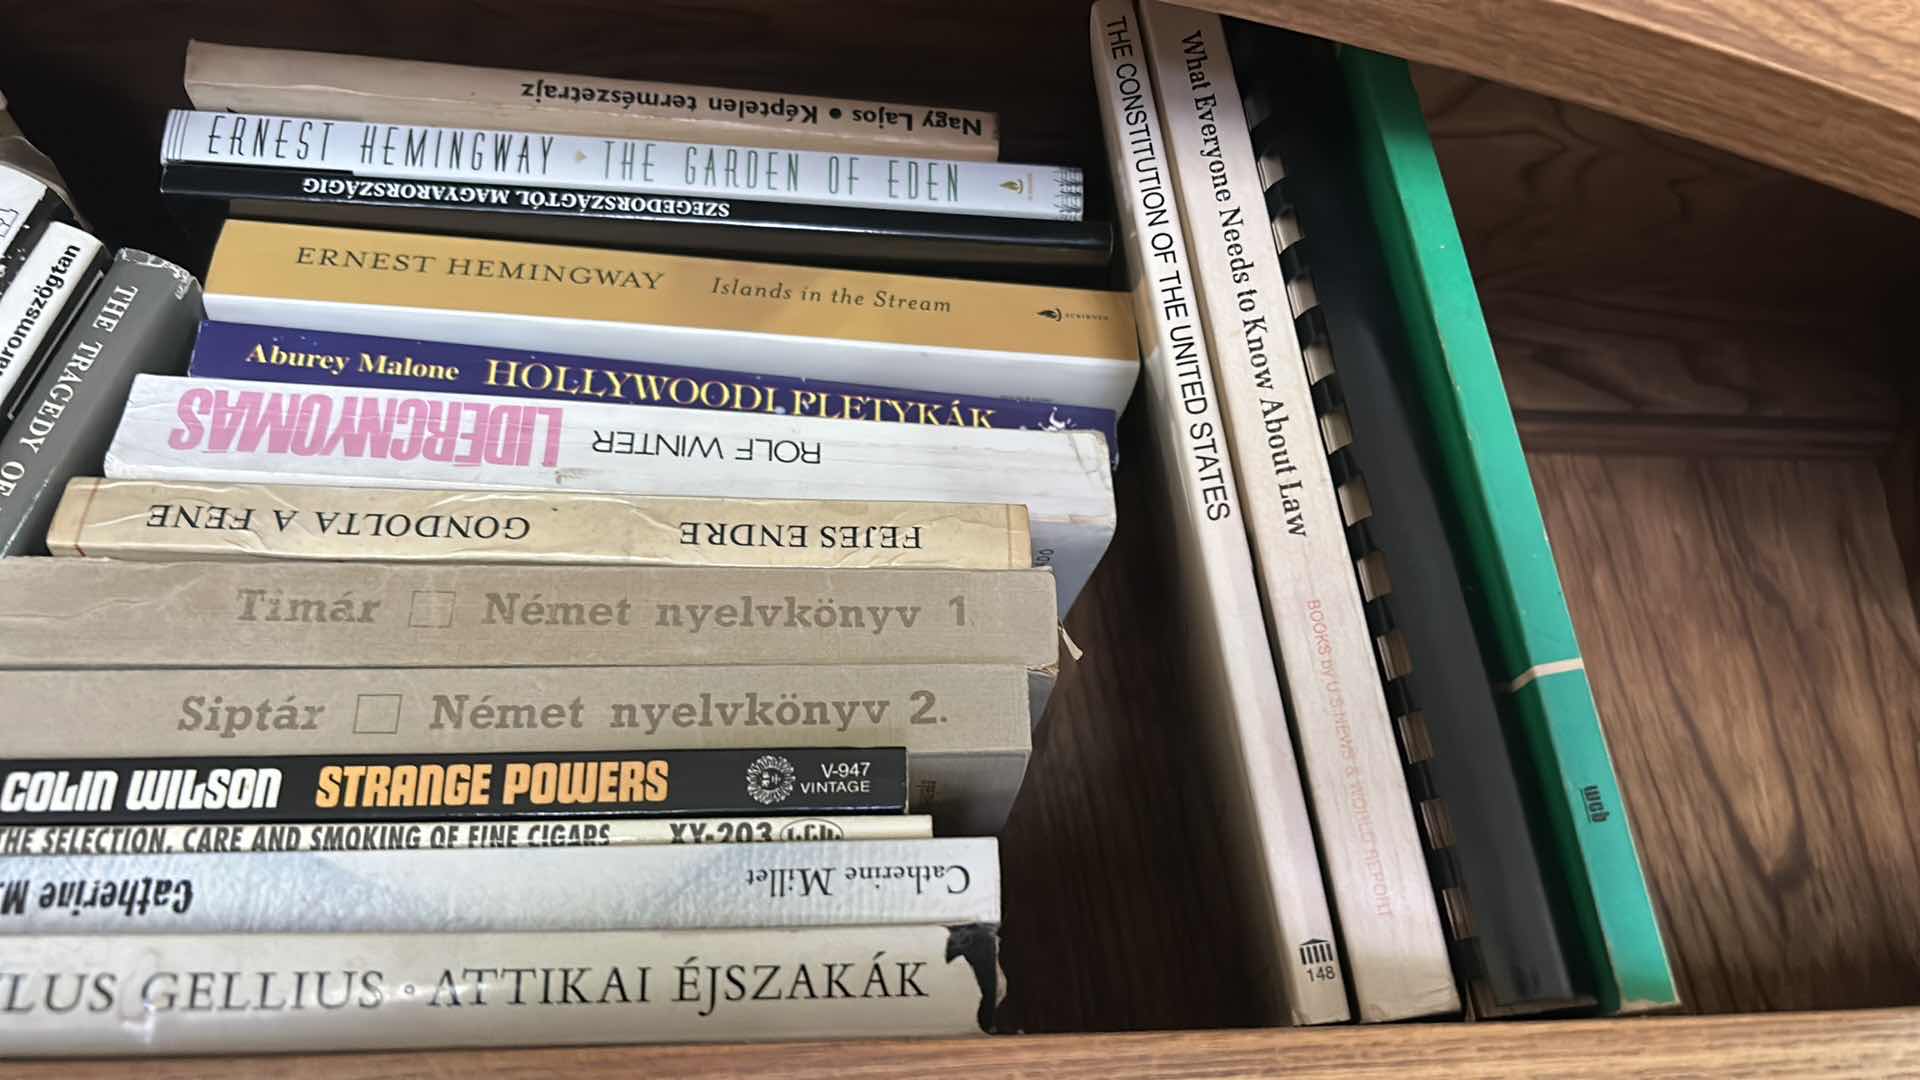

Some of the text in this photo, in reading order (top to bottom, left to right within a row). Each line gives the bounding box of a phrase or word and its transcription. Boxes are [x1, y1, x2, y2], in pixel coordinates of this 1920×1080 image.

[521, 80, 982, 136] Nagy Lajos Képtelen természetrajz
[208, 115, 959, 202] ERNEST HEMINGWAY THE GARDEN OF EDEN
[302, 178, 730, 218] SZEGEDORSZÁGTÓL MAGYARORSZÁGIG
[296, 247, 666, 289] ERNEST HEMINGWAY
[1106, 16, 1230, 521] THE CONSTITUTION OF THE UNITED STATES
[1182, 30, 1307, 537] What Everyone Needs to Know About Law
[92, 284, 139, 333] THE
[712, 277, 952, 313] Islands in the Stream
[19, 340, 104, 455] TRAGEDY
[245, 343, 996, 429] Aburey Malone HOLLYWOODI PLETYKÁK
[592, 430, 821, 464] ROLF WINTER
[146, 504, 531, 540] GONDOLTA A FENE
[679, 521, 922, 549] FEJES ENDRE
[236, 587, 381, 623] Timár
[481, 591, 632, 626] Német
[655, 595, 922, 635] nyelvkönyv
[1307, 599, 1333, 657] BOOKS
[177, 690, 948, 739] Siptár Német nyelvkönyv 2.
[1, 768, 282, 812] COLIN WILSON
[315, 760, 670, 808] STRANGE POWERS
[800, 780, 871, 794] VINTAGE
[820, 762, 872, 779] V-947
[183, 826, 243, 853] CARE
[252, 825, 301, 852] AND
[310, 825, 422, 850] SMOKING
[430, 825, 459, 849] OF
[468, 824, 519, 848] FINE
[38, 876, 194, 916] Catherine
[746, 864, 971, 898] Catherine Millet
[0, 970, 386, 1014] LUS GELLIUS
[428, 950, 930, 1017] ATTIKAI ÉJSZAKÁK
[1306, 965, 1336, 981] 148
